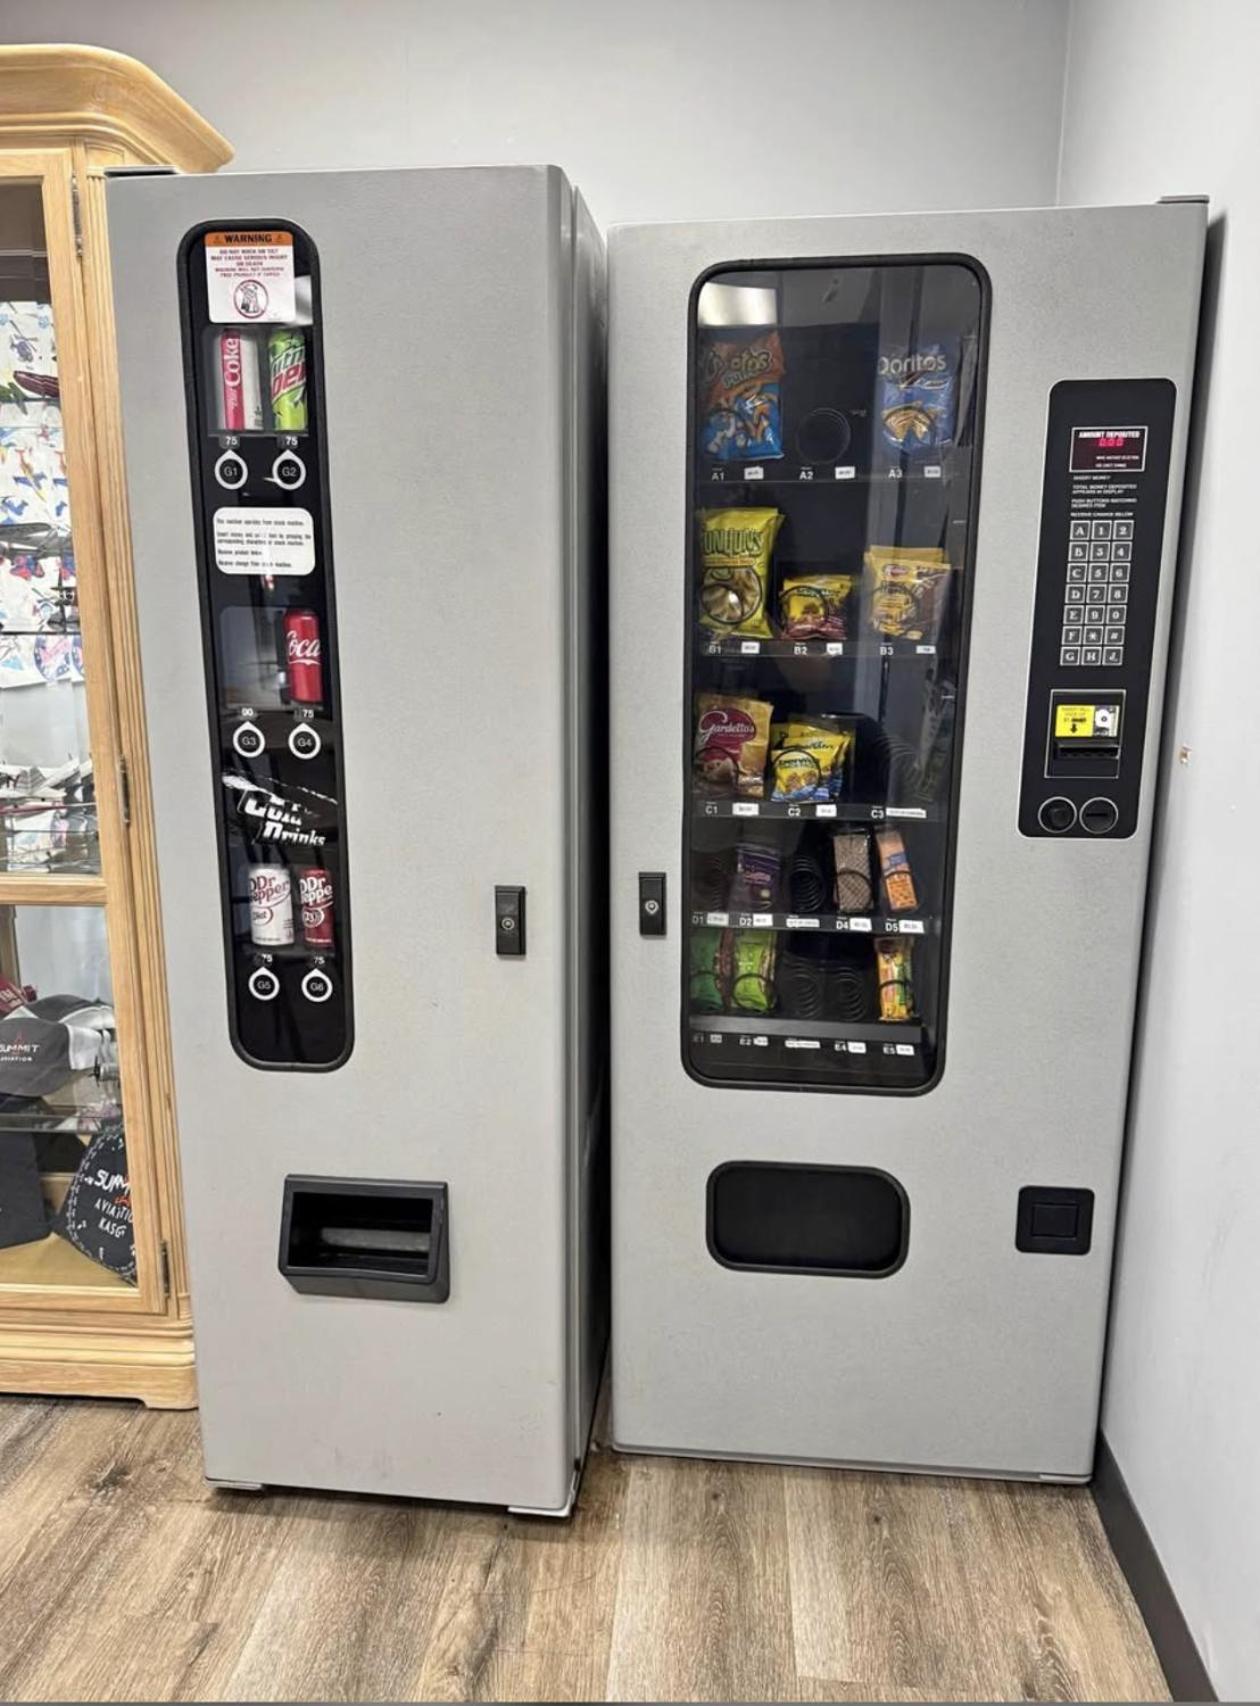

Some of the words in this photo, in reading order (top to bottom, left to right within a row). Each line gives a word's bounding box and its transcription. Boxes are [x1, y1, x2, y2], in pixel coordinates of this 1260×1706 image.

[224, 233, 273, 243] WARNING
[224, 338, 241, 387] Coke
[878, 354, 947, 375] Doritos
[225, 436, 238, 446] 75
[285, 436, 299, 447] 75
[223, 466, 238, 477] G1
[281, 466, 297, 477] G2
[799, 471, 814, 481] A2
[711, 472, 725, 481] A1
[1075, 526, 1085, 536] A
[1099, 526, 1104, 535] 1
[1118, 526, 1127, 535] 2
[1074, 548, 1084, 557] B
[1096, 548, 1104, 557] 3
[1117, 548, 1125, 557] 4
[1071, 569, 1081, 578] C
[1094, 569, 1102, 578] 5
[1116, 569, 1123, 578] 6
[1071, 590, 1081, 599] D
[1092, 590, 1100, 599] 7
[1114, 590, 1122, 599] 8
[1069, 610, 1078, 620] E
[1091, 611, 1098, 620] 9
[1112, 611, 1120, 620] 0
[1068, 631, 1076, 640] F
[793, 646, 808, 655] B2
[879, 646, 895, 656] B3
[1065, 652, 1075, 661] G
[1086, 652, 1097, 661] H
[1109, 652, 1118, 661] J
[241, 736, 257, 746] G3
[297, 738, 312, 747] G4
[705, 805, 718, 815] C1
[787, 808, 801, 817] C2
[263, 821, 326, 846] Drinks
[739, 917, 753, 927] D2
[885, 922, 899, 932] D5
